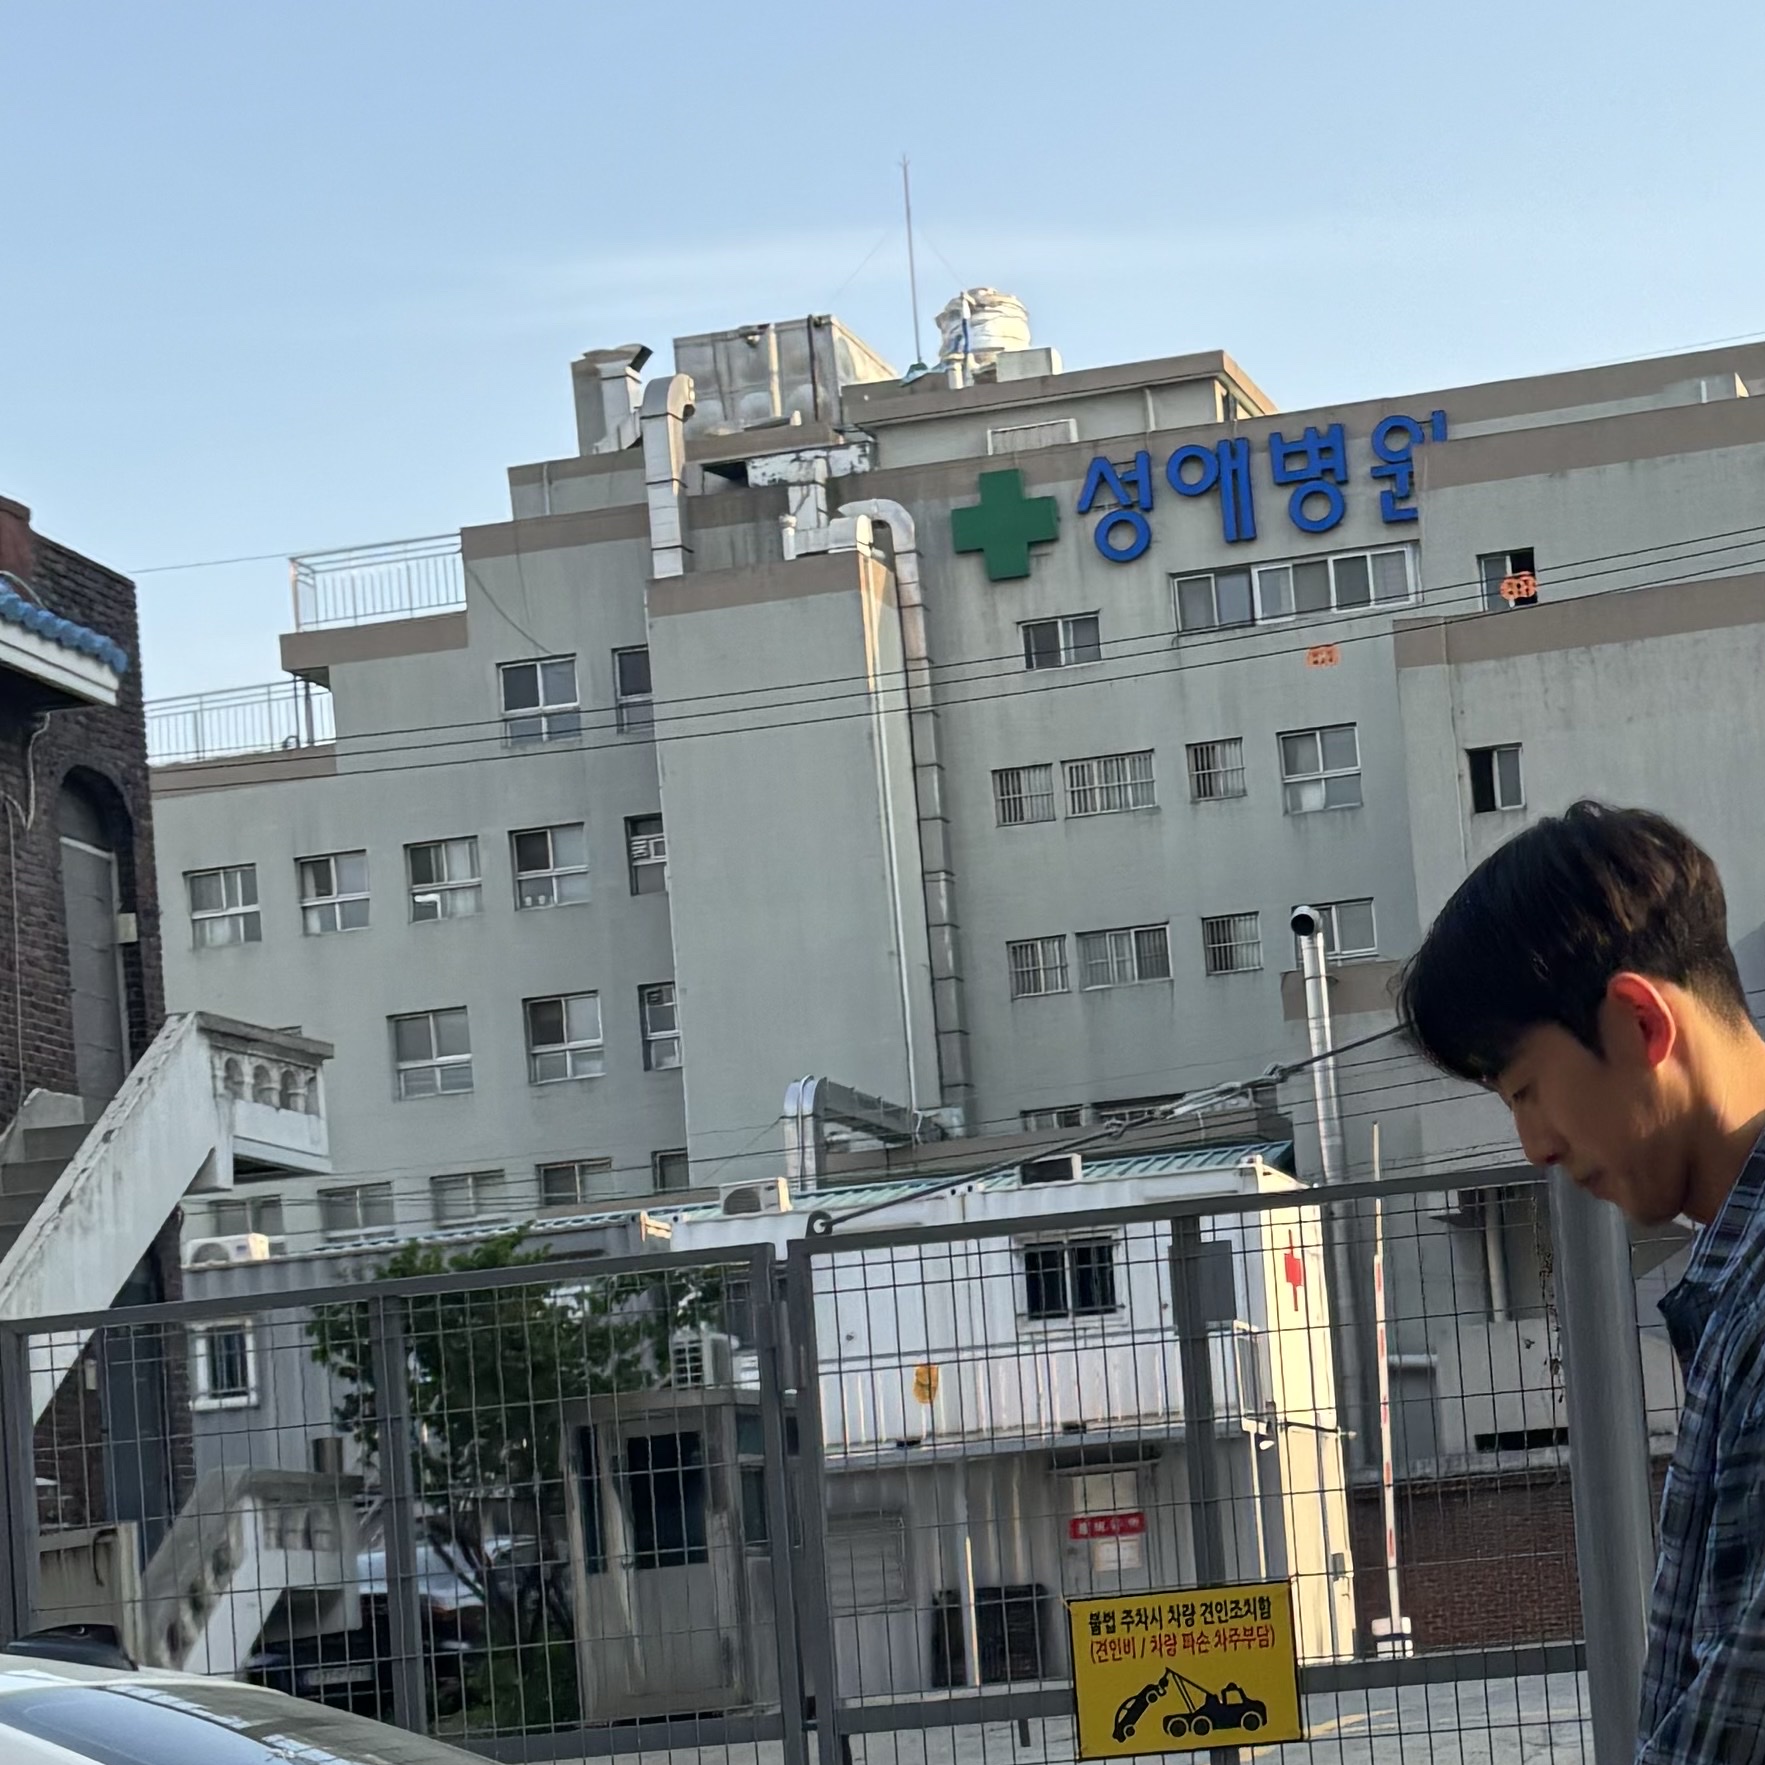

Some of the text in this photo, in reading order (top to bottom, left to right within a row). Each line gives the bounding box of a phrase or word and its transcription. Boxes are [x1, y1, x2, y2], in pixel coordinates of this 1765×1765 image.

[1076, 410, 1448, 563] 성애병원
[1088, 1610, 1116, 1636] 불법
[1120, 1605, 1163, 1633] 주차시
[1167, 1602, 1196, 1629] 차량
[1090, 1624, 1276, 1664] (견인비 / 차량 파손 차주부담)
